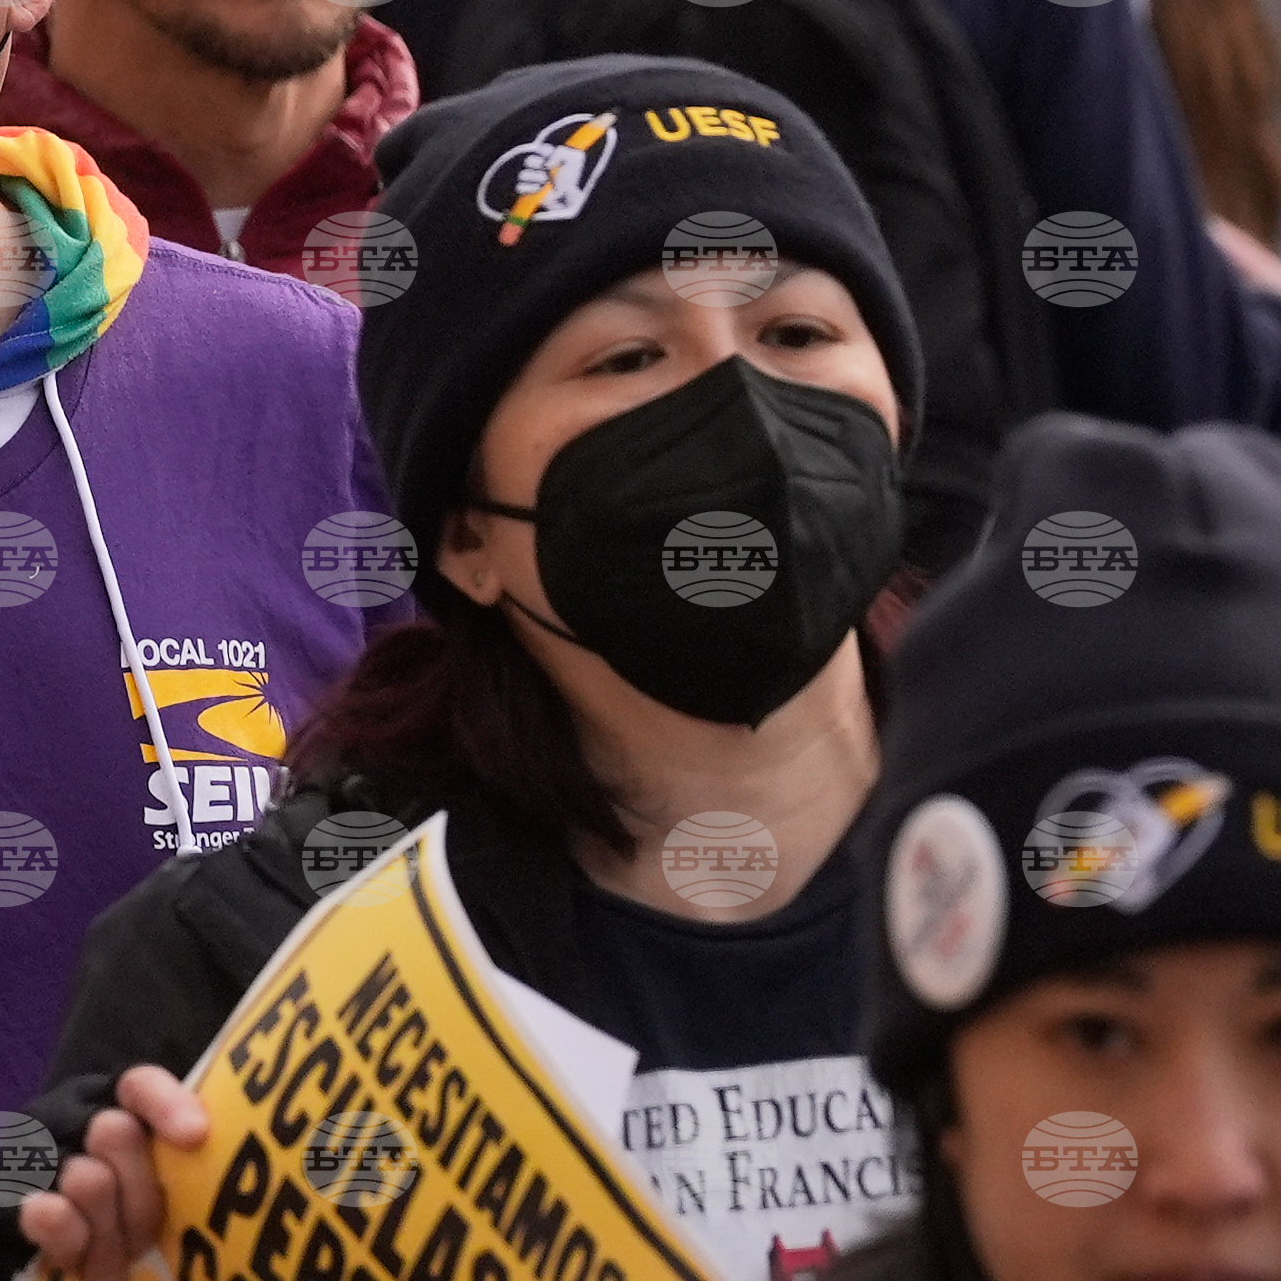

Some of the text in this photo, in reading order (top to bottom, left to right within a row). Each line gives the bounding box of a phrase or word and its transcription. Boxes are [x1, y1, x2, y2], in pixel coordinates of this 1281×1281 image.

[644, 106, 781, 148] UESF
[218, 639, 265, 669] 1021
[153, 830, 240, 851] Stnger
